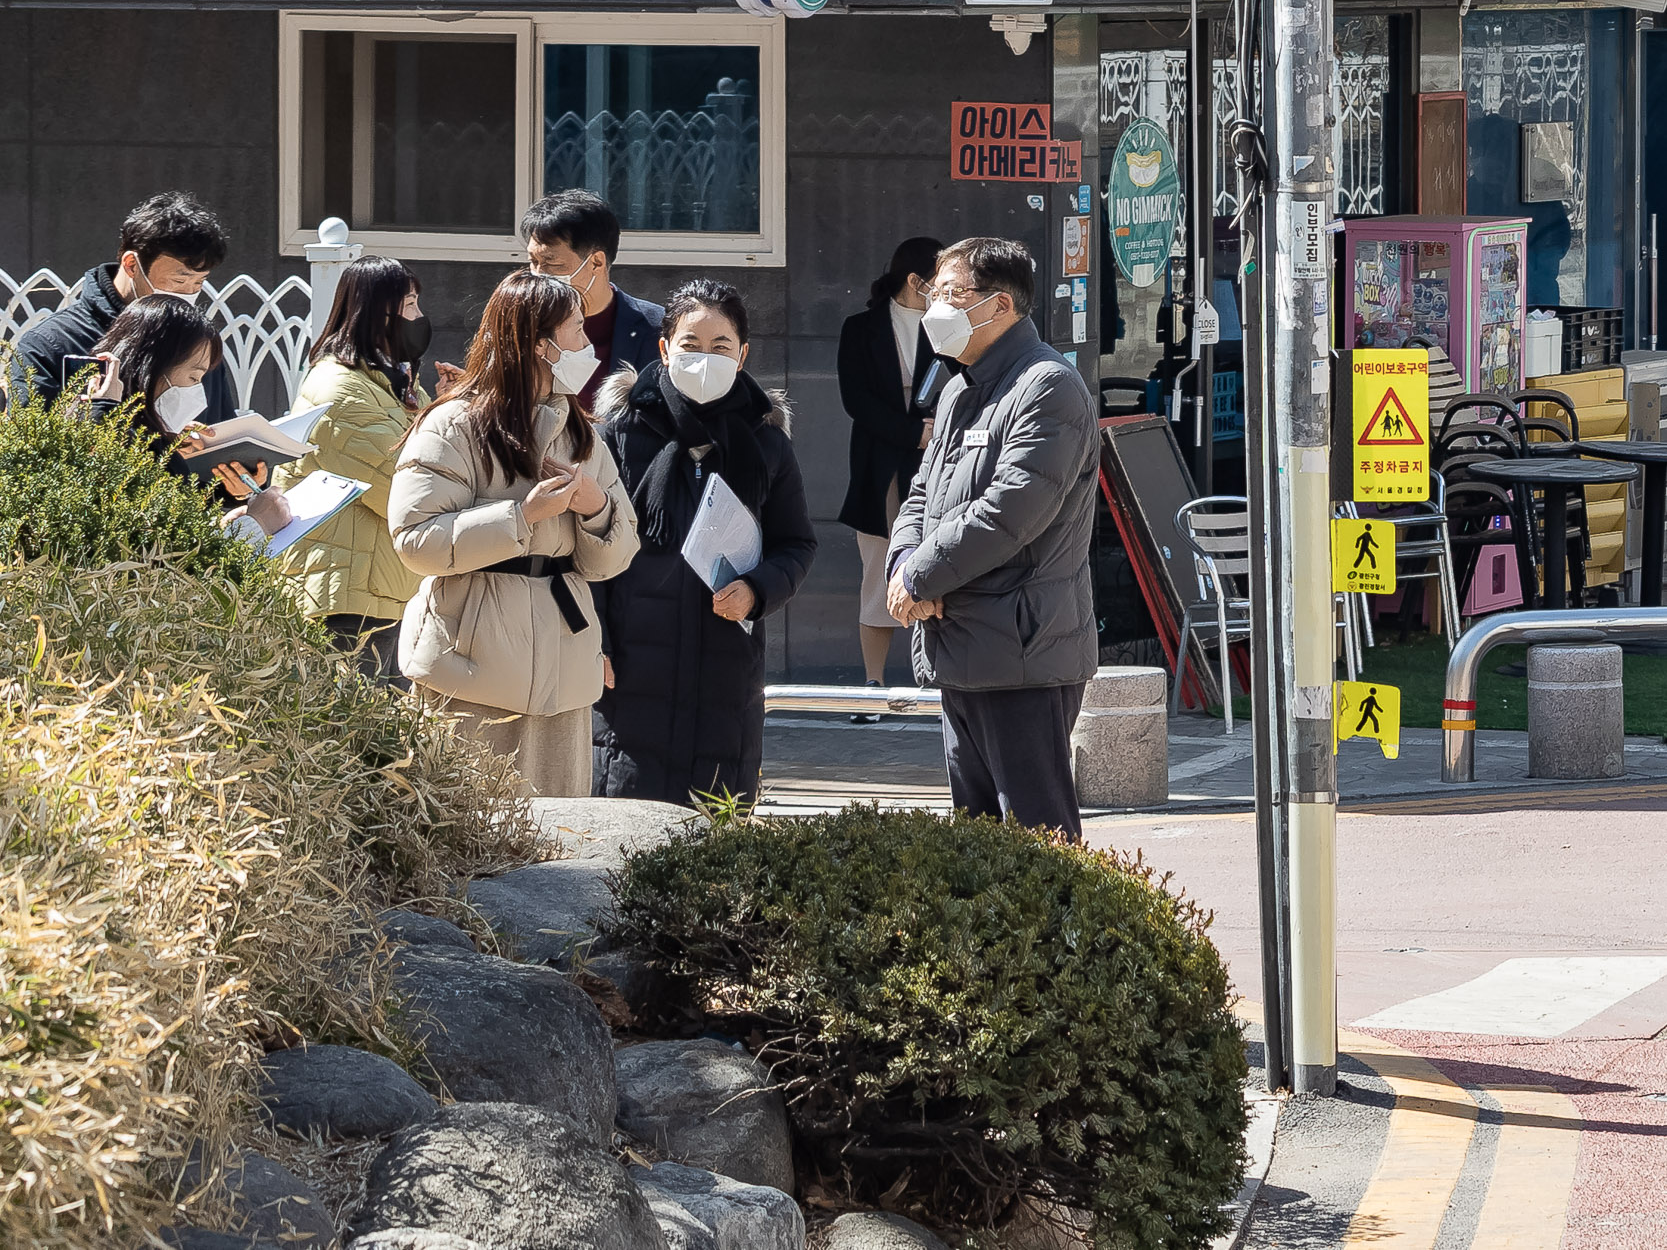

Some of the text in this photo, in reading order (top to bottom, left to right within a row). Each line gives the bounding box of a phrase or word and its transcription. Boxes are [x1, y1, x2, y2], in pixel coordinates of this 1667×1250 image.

[960, 106, 1047, 139] 아이스
[959, 144, 1077, 178] 아메리카노
[1116, 198, 1130, 226] NO
[1132, 194, 1173, 225] GIMMICK
[1306, 203, 1318, 262] 인부모집
[1124, 241, 1141, 250] COFFEE
[1386, 243, 1446, 257] 천원의 행복
[1364, 284, 1380, 302] BOX
[1353, 362, 1428, 375] 어린이보호구역
[1360, 460, 1423, 474] 주정차금지
